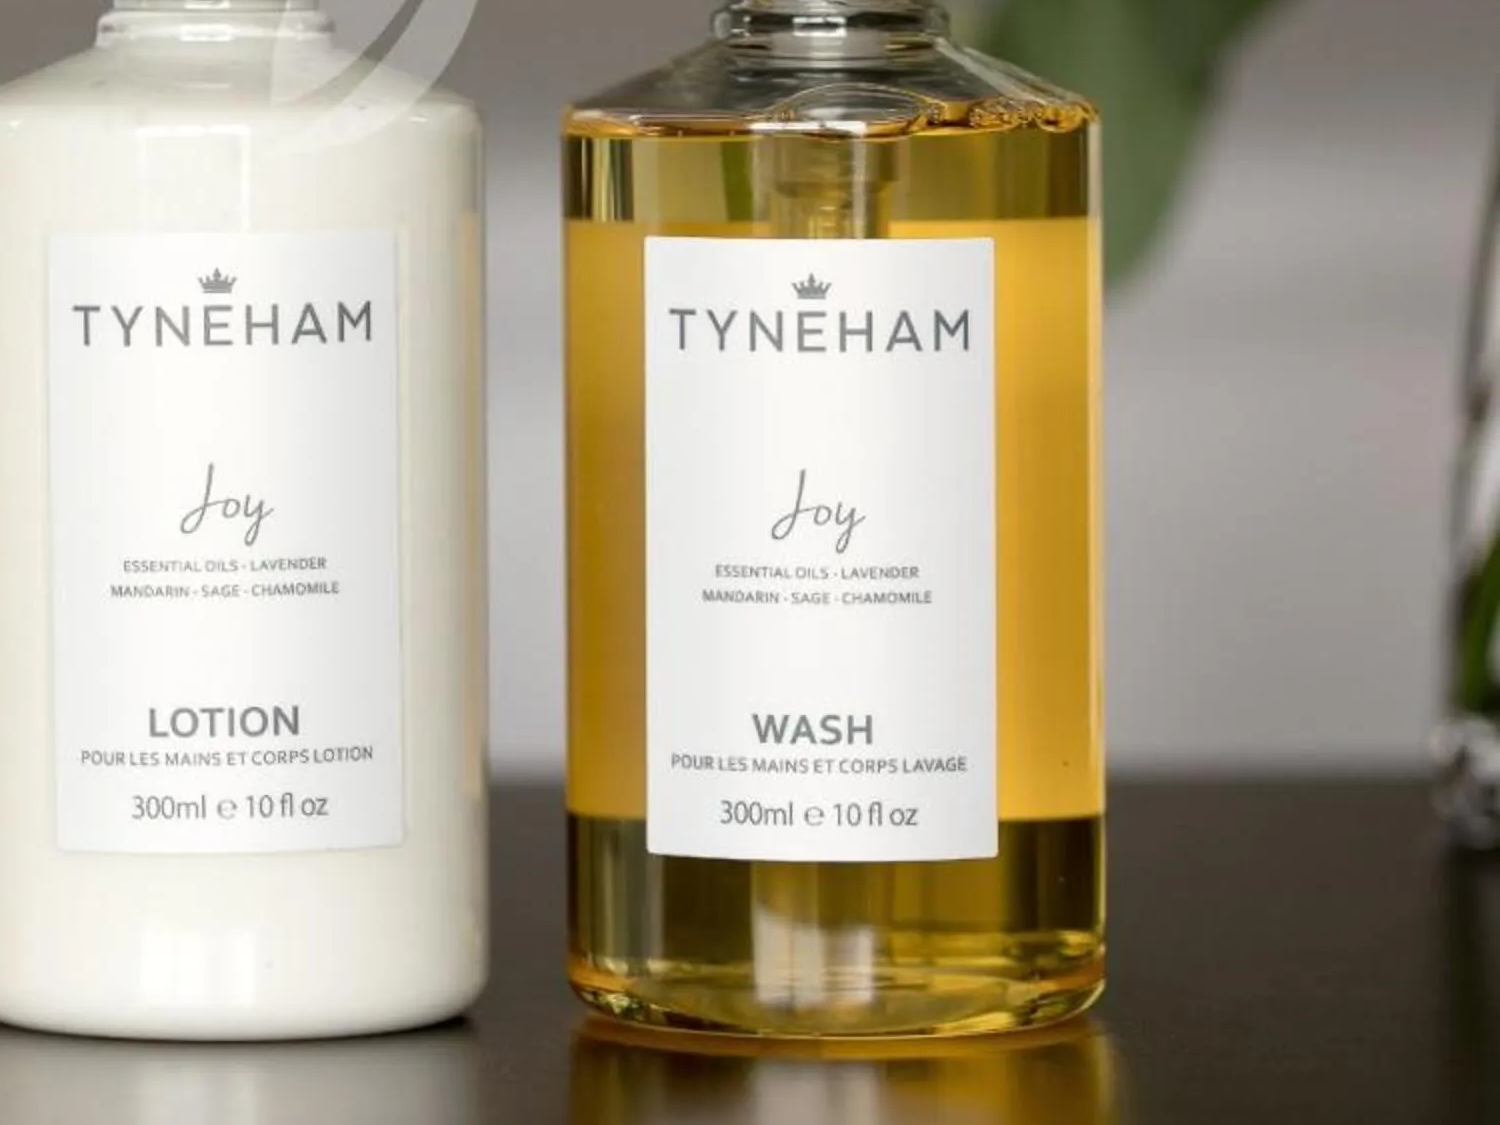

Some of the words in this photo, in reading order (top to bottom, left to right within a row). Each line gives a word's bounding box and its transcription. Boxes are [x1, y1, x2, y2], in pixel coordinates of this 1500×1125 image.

[72, 301, 373, 347] TYNEHAM
[669, 309, 970, 354] TYNEHAM
[179, 461, 274, 547] Joy
[771, 468, 866, 554] Joy
[123, 560, 201, 573] ESSENTIAL
[204, 559, 238, 573] OILS
[250, 556, 327, 572] LAVENDER
[715, 564, 791, 579] ESSENTIAL
[795, 565, 829, 580] OILS
[841, 566, 920, 580] LAVENDER
[110, 584, 190, 598] MANDARIN
[201, 584, 240, 598] SAGE
[251, 581, 339, 597] CHAMOMILE
[701, 589, 779, 604] MANDARIN
[790, 591, 830, 604] SAGE
[842, 590, 932, 604] CHAMOMILE
[148, 705, 301, 739] LOTION
[751, 713, 874, 746] WASH
[81, 750, 125, 766] POUR
[130, 751, 159, 766] LES
[165, 751, 221, 767] MAINS
[227, 750, 247, 766] ET
[251, 749, 310, 766] CORPS
[313, 745, 373, 763] LOTION
[671, 753, 714, 770] POUR
[719, 756, 747, 772] LES
[752, 758, 809, 774] MAINS
[814, 759, 834, 774] ET
[839, 758, 898, 774] CORPS
[902, 756, 968, 773] LAVAGE
[131, 794, 207, 820] 300ml
[245, 794, 274, 819] 10
[280, 792, 294, 818] fl
[301, 796, 329, 817] oz
[719, 800, 794, 827] 300ml
[833, 802, 861, 827] 10
[868, 800, 883, 826] fl
[890, 805, 918, 826] oz
